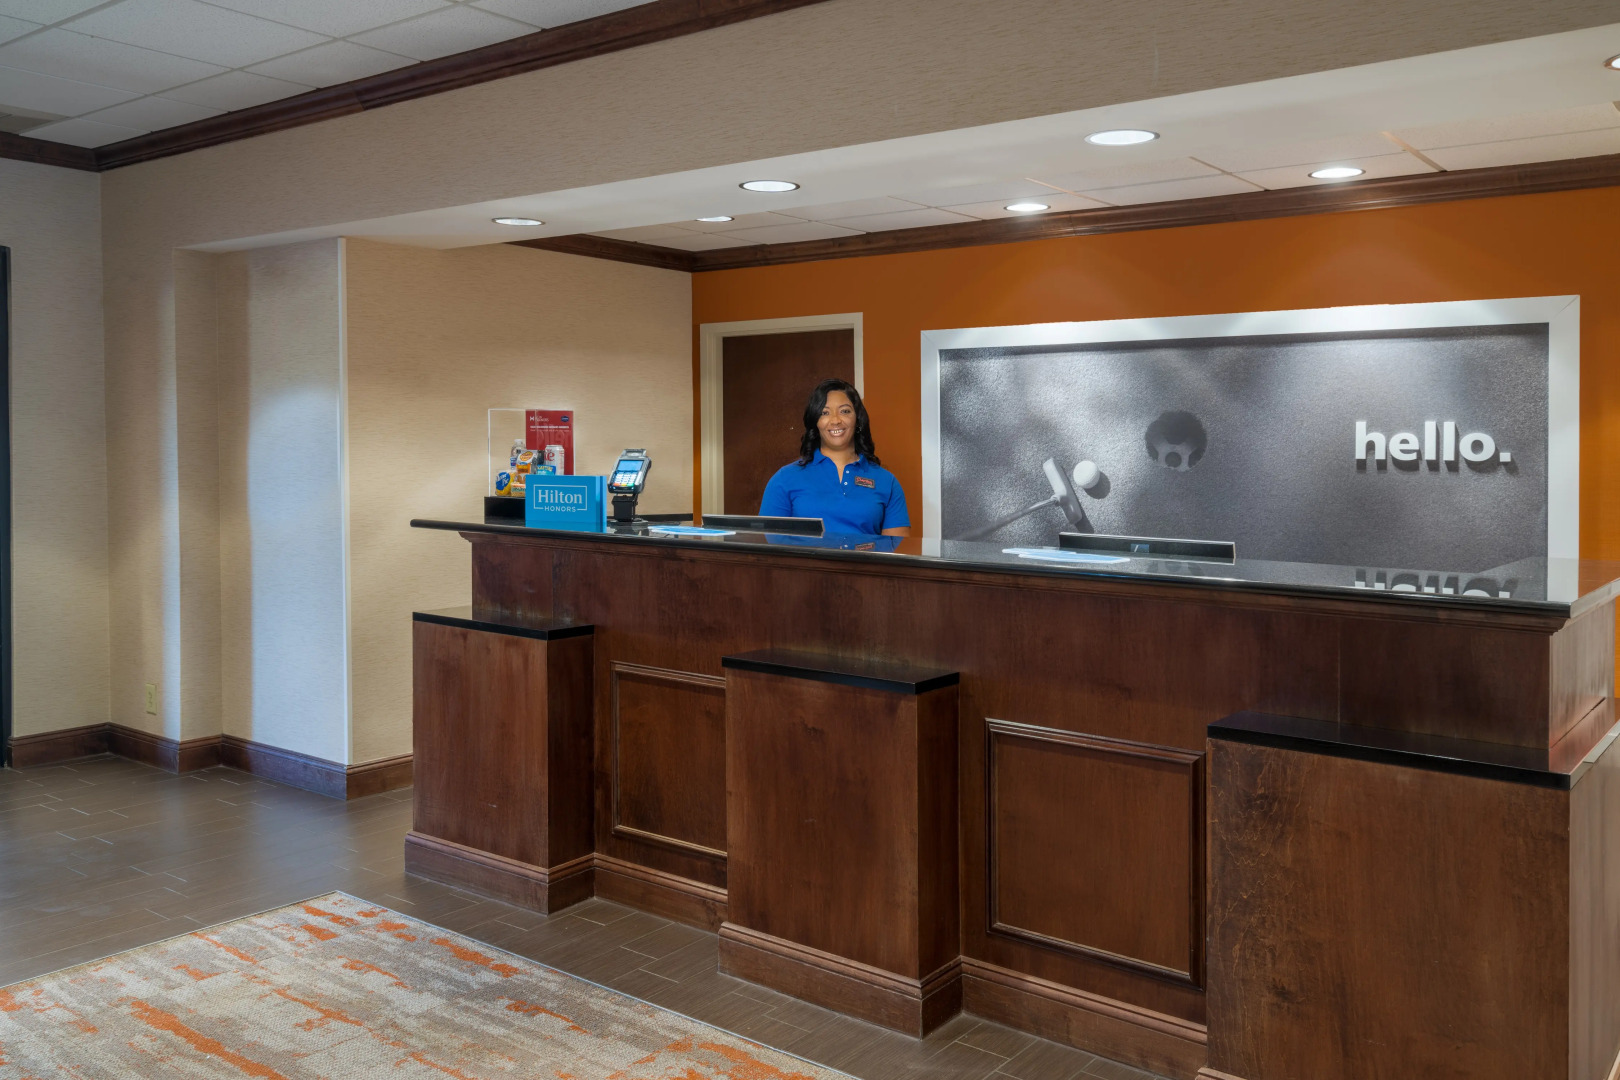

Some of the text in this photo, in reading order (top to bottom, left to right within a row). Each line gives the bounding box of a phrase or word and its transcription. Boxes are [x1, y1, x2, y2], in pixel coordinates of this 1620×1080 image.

[1355, 421, 1512, 462] hello.
[538, 489, 583, 504] Hilton
[544, 505, 577, 513] HONORS
